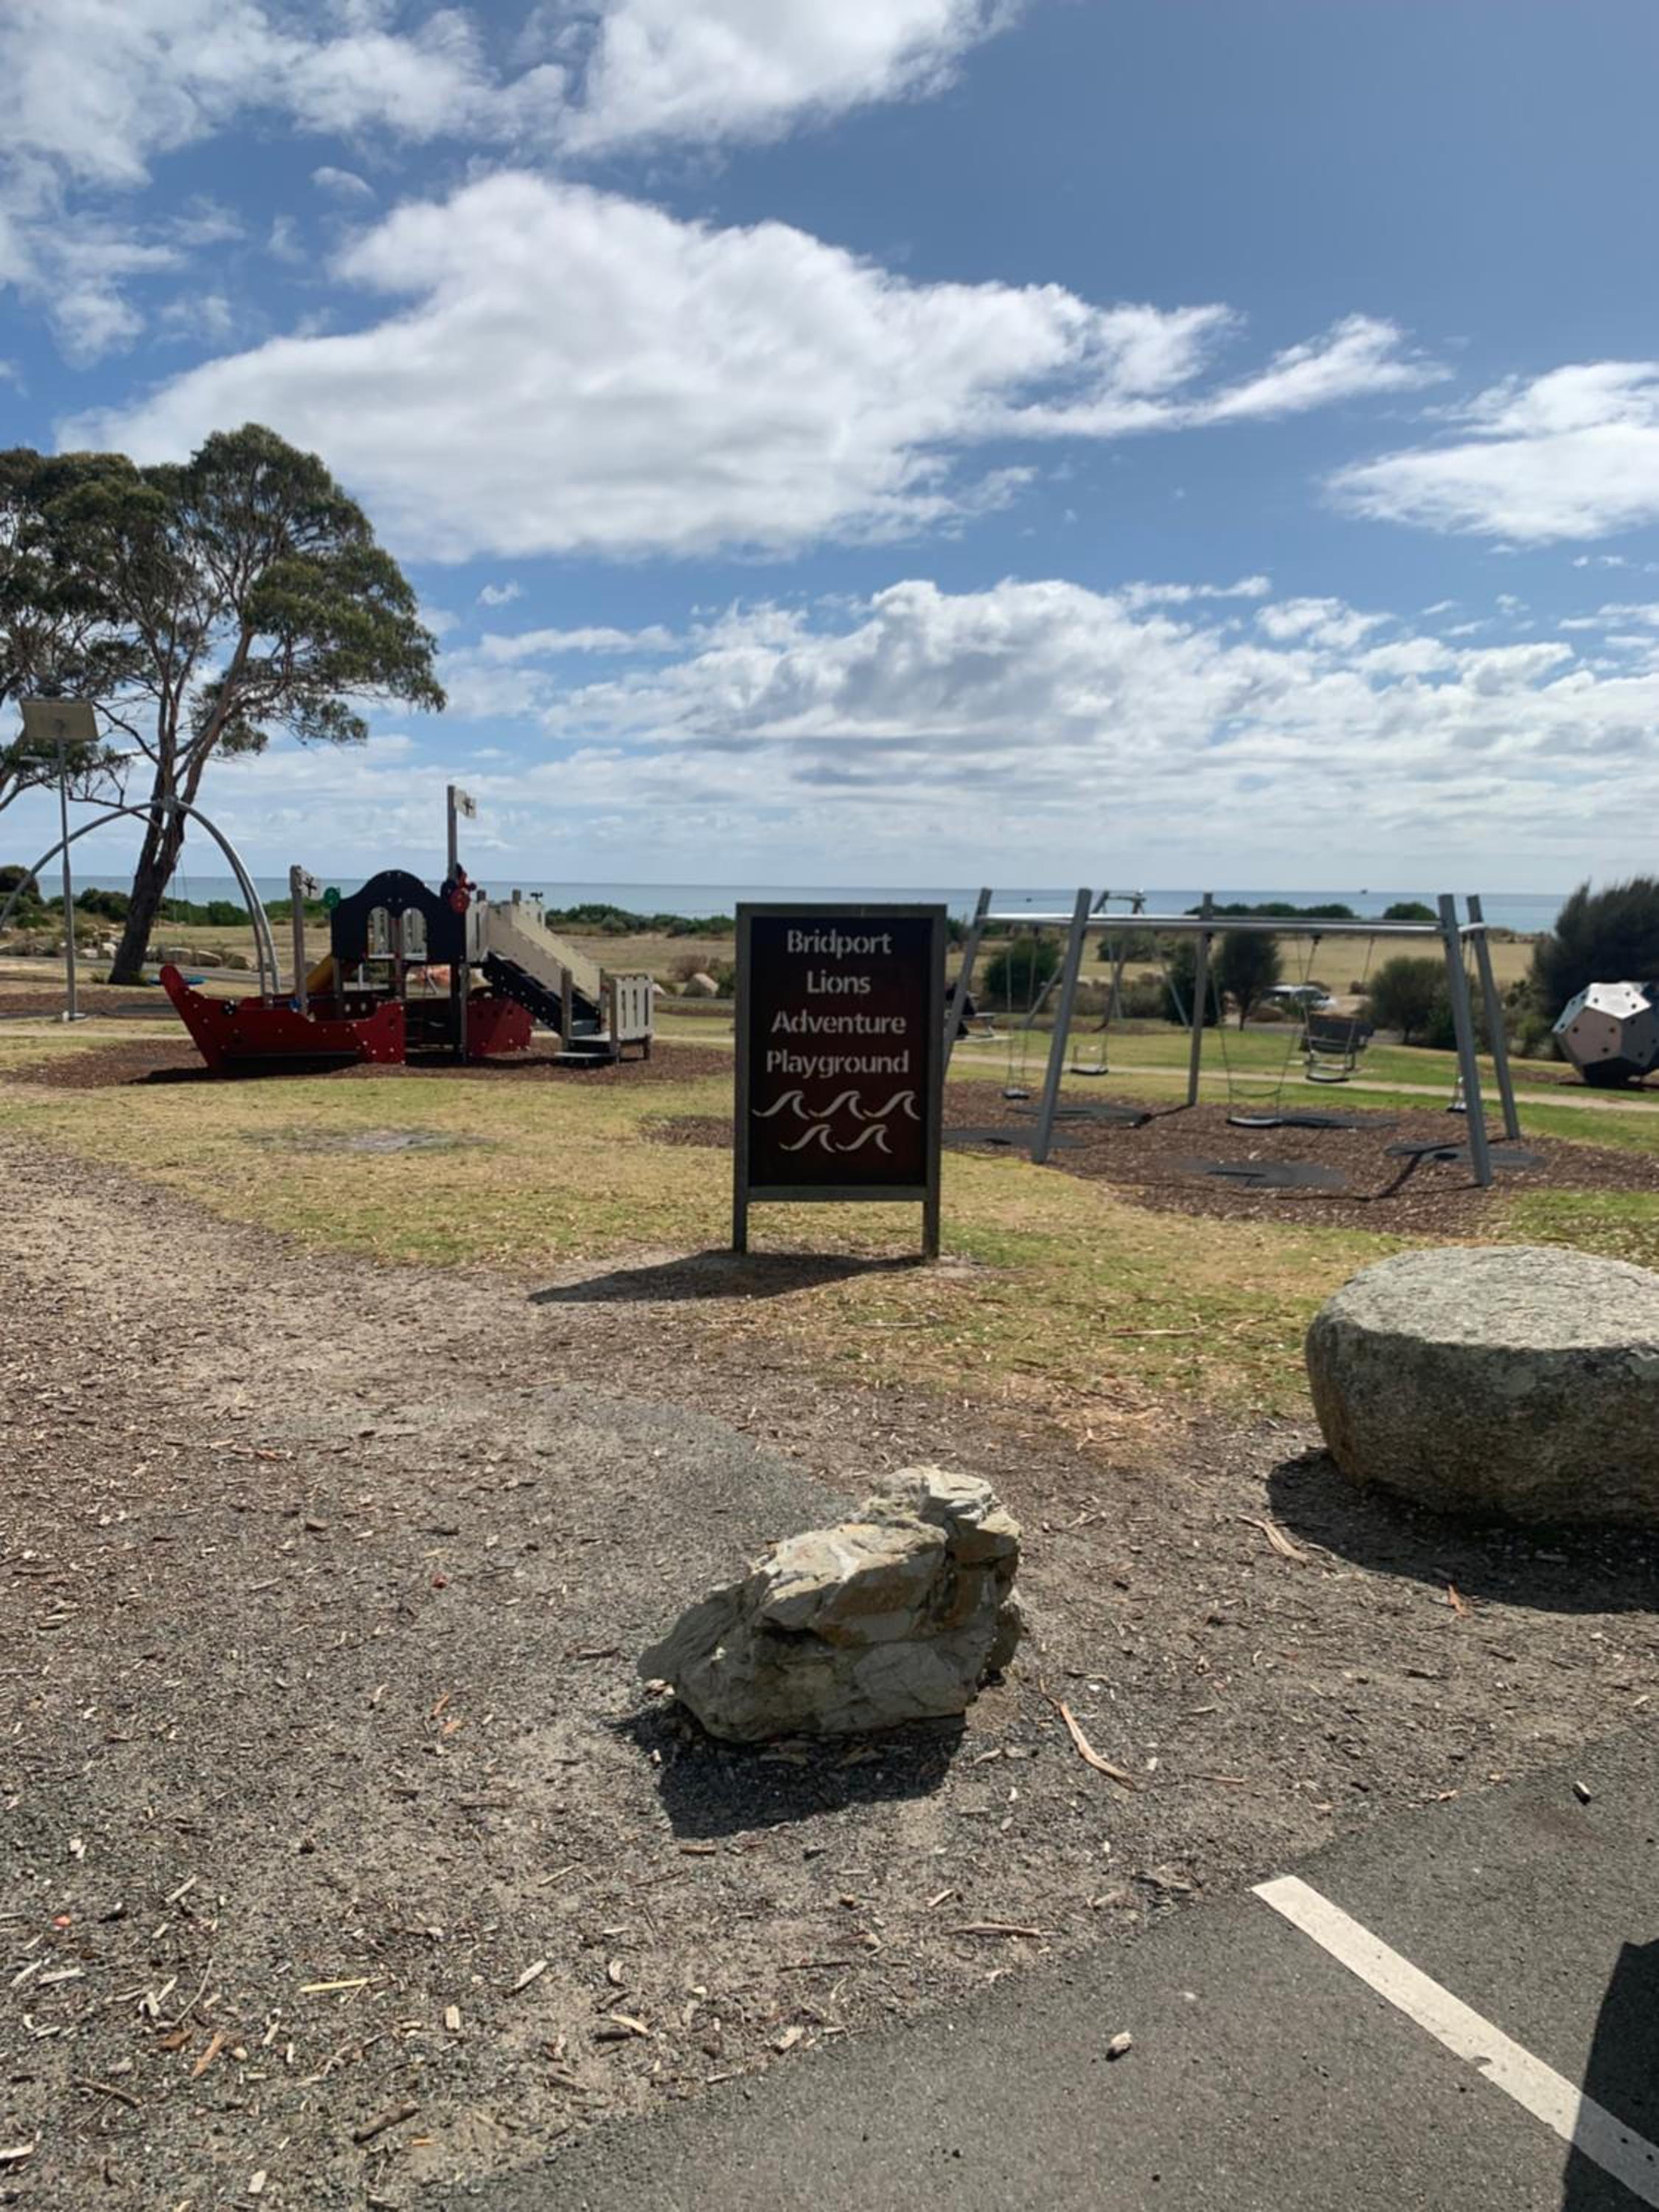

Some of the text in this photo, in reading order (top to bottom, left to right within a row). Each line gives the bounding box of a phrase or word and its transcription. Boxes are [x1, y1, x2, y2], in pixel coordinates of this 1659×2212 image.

[787, 930, 892, 959] Bridport
[807, 970, 872, 994] Lions
[771, 1010, 907, 1034] Adventure
[766, 1050, 910, 1079] Playground
